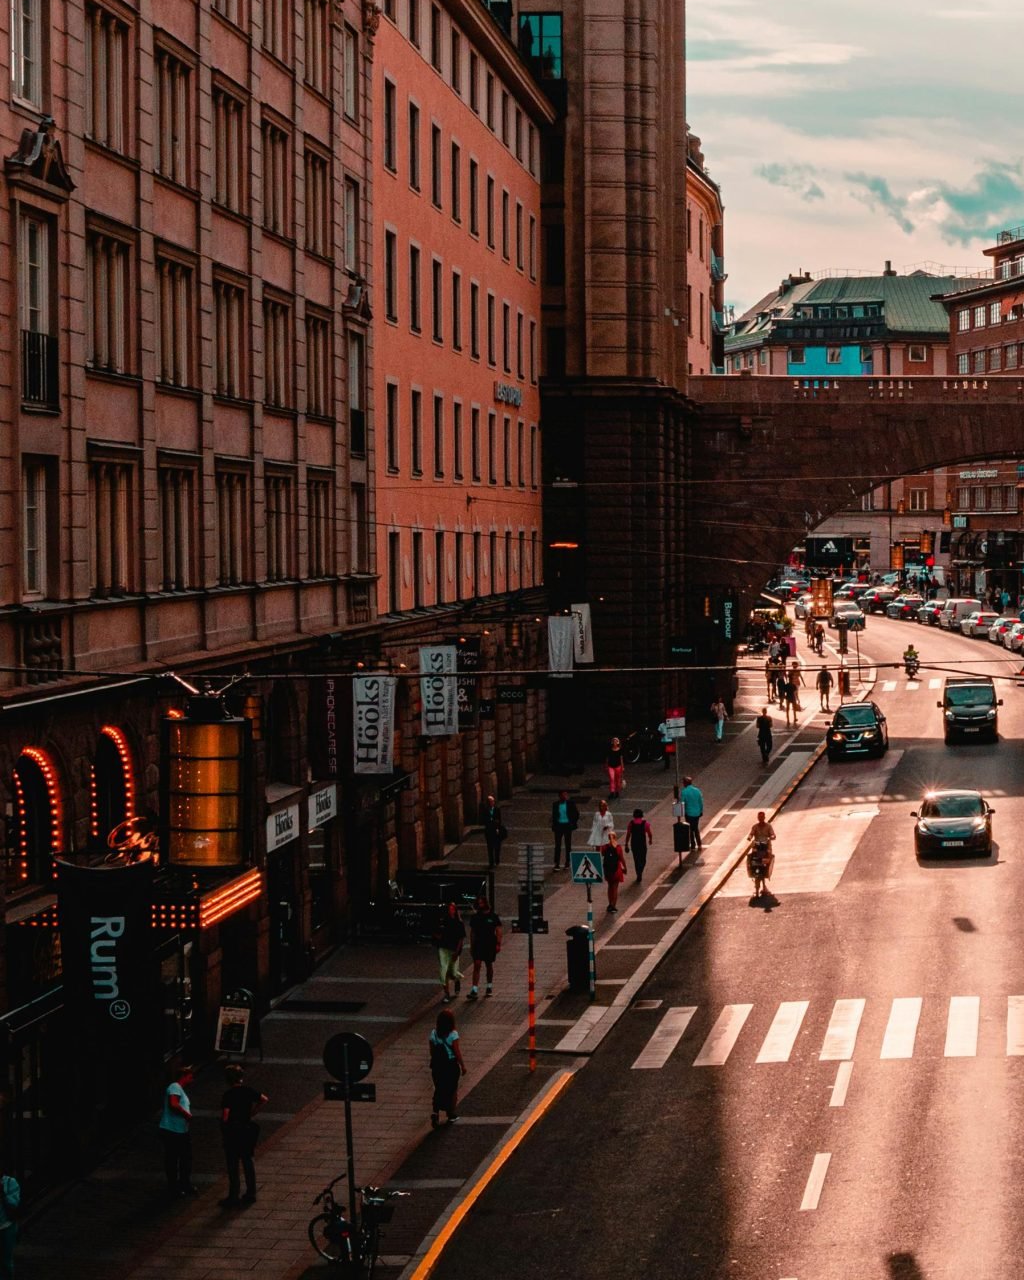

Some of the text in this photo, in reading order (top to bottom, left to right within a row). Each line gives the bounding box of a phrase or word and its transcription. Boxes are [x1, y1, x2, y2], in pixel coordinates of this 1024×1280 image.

[724, 602, 732, 639] Barbour
[425, 652, 446, 728] Hööks
[457, 678, 476, 686] USHI
[457, 688, 468, 702] &
[458, 704, 473, 713] HAI
[326, 679, 337, 774] IPHONECARE.SE
[356, 679, 380, 766] Hööks
[90, 916, 126, 1000] Rum
